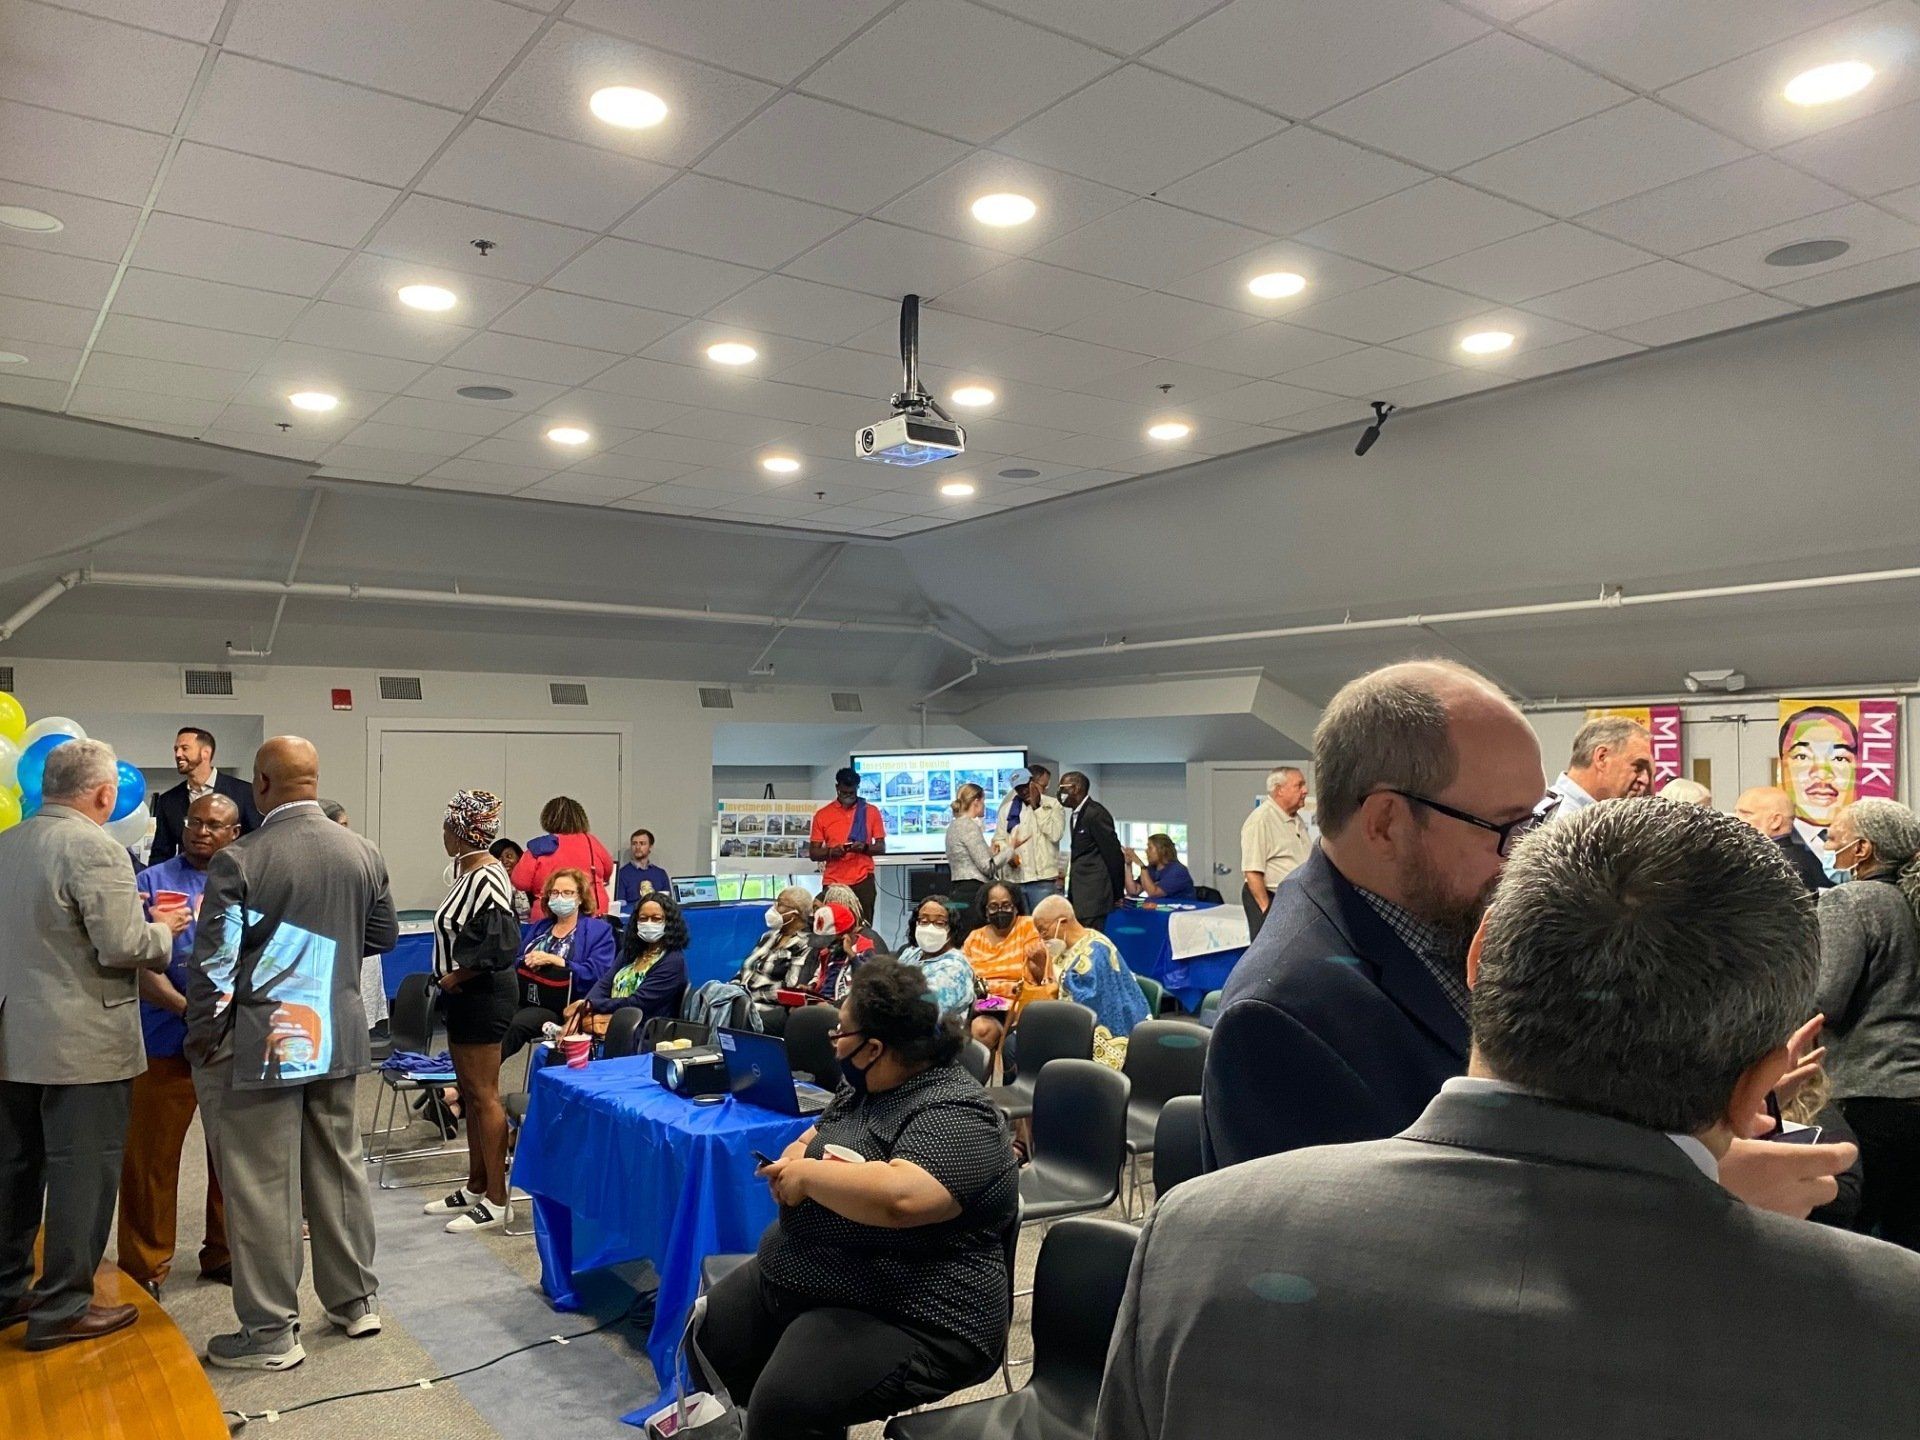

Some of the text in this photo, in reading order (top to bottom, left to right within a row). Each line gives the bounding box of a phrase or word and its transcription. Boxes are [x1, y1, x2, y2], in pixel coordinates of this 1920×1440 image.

[1653, 716, 1678, 782] MLK
[1862, 712, 1893, 786] MLK
[725, 802, 772, 813] Investments
